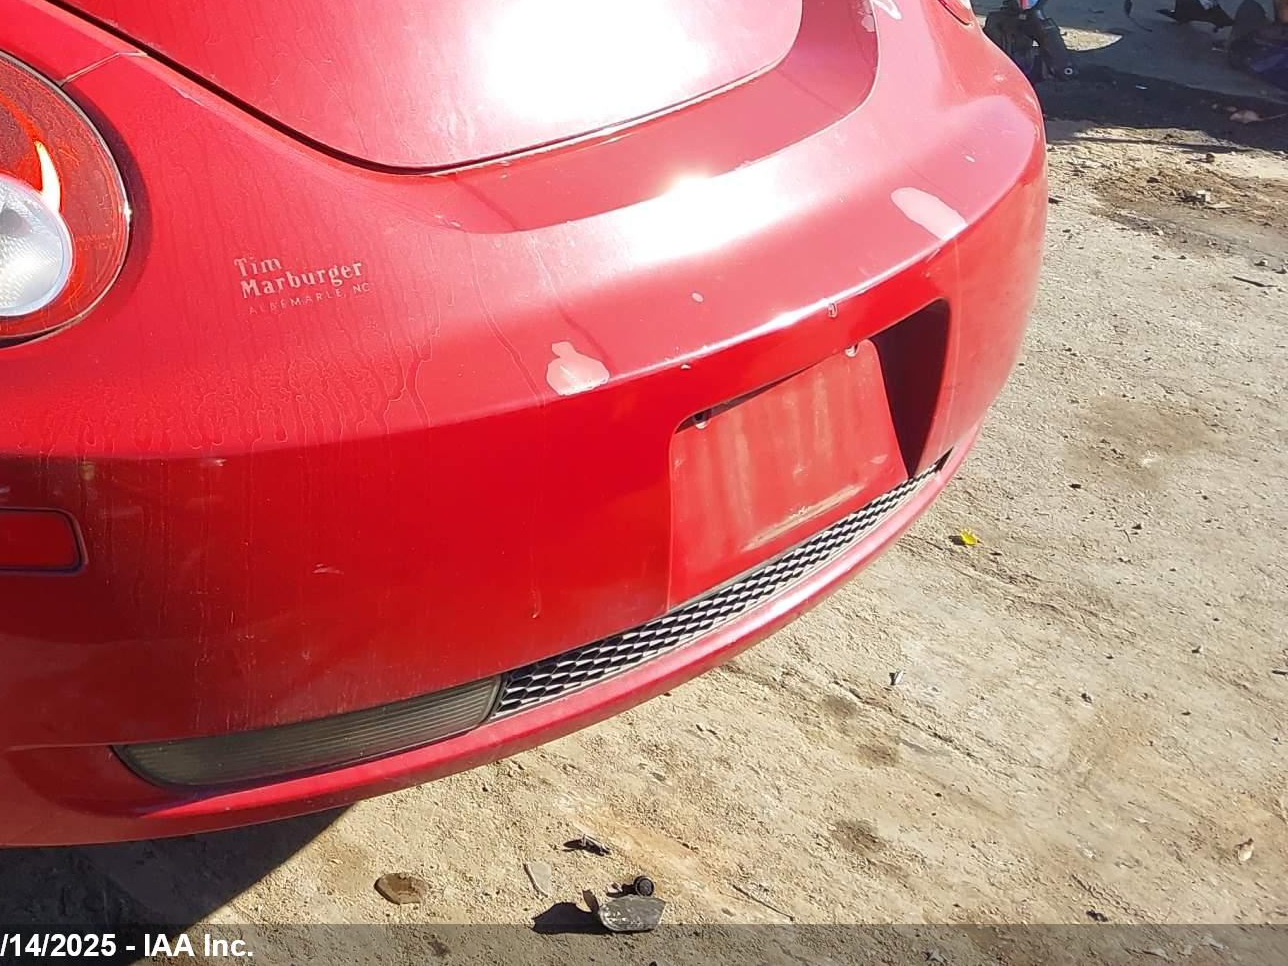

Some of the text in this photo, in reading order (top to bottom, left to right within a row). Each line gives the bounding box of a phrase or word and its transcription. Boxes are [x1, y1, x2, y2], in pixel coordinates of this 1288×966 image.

[233, 256, 282, 277] Tim
[240, 261, 362, 299] Marburger
[352, 283, 370, 294] NC
